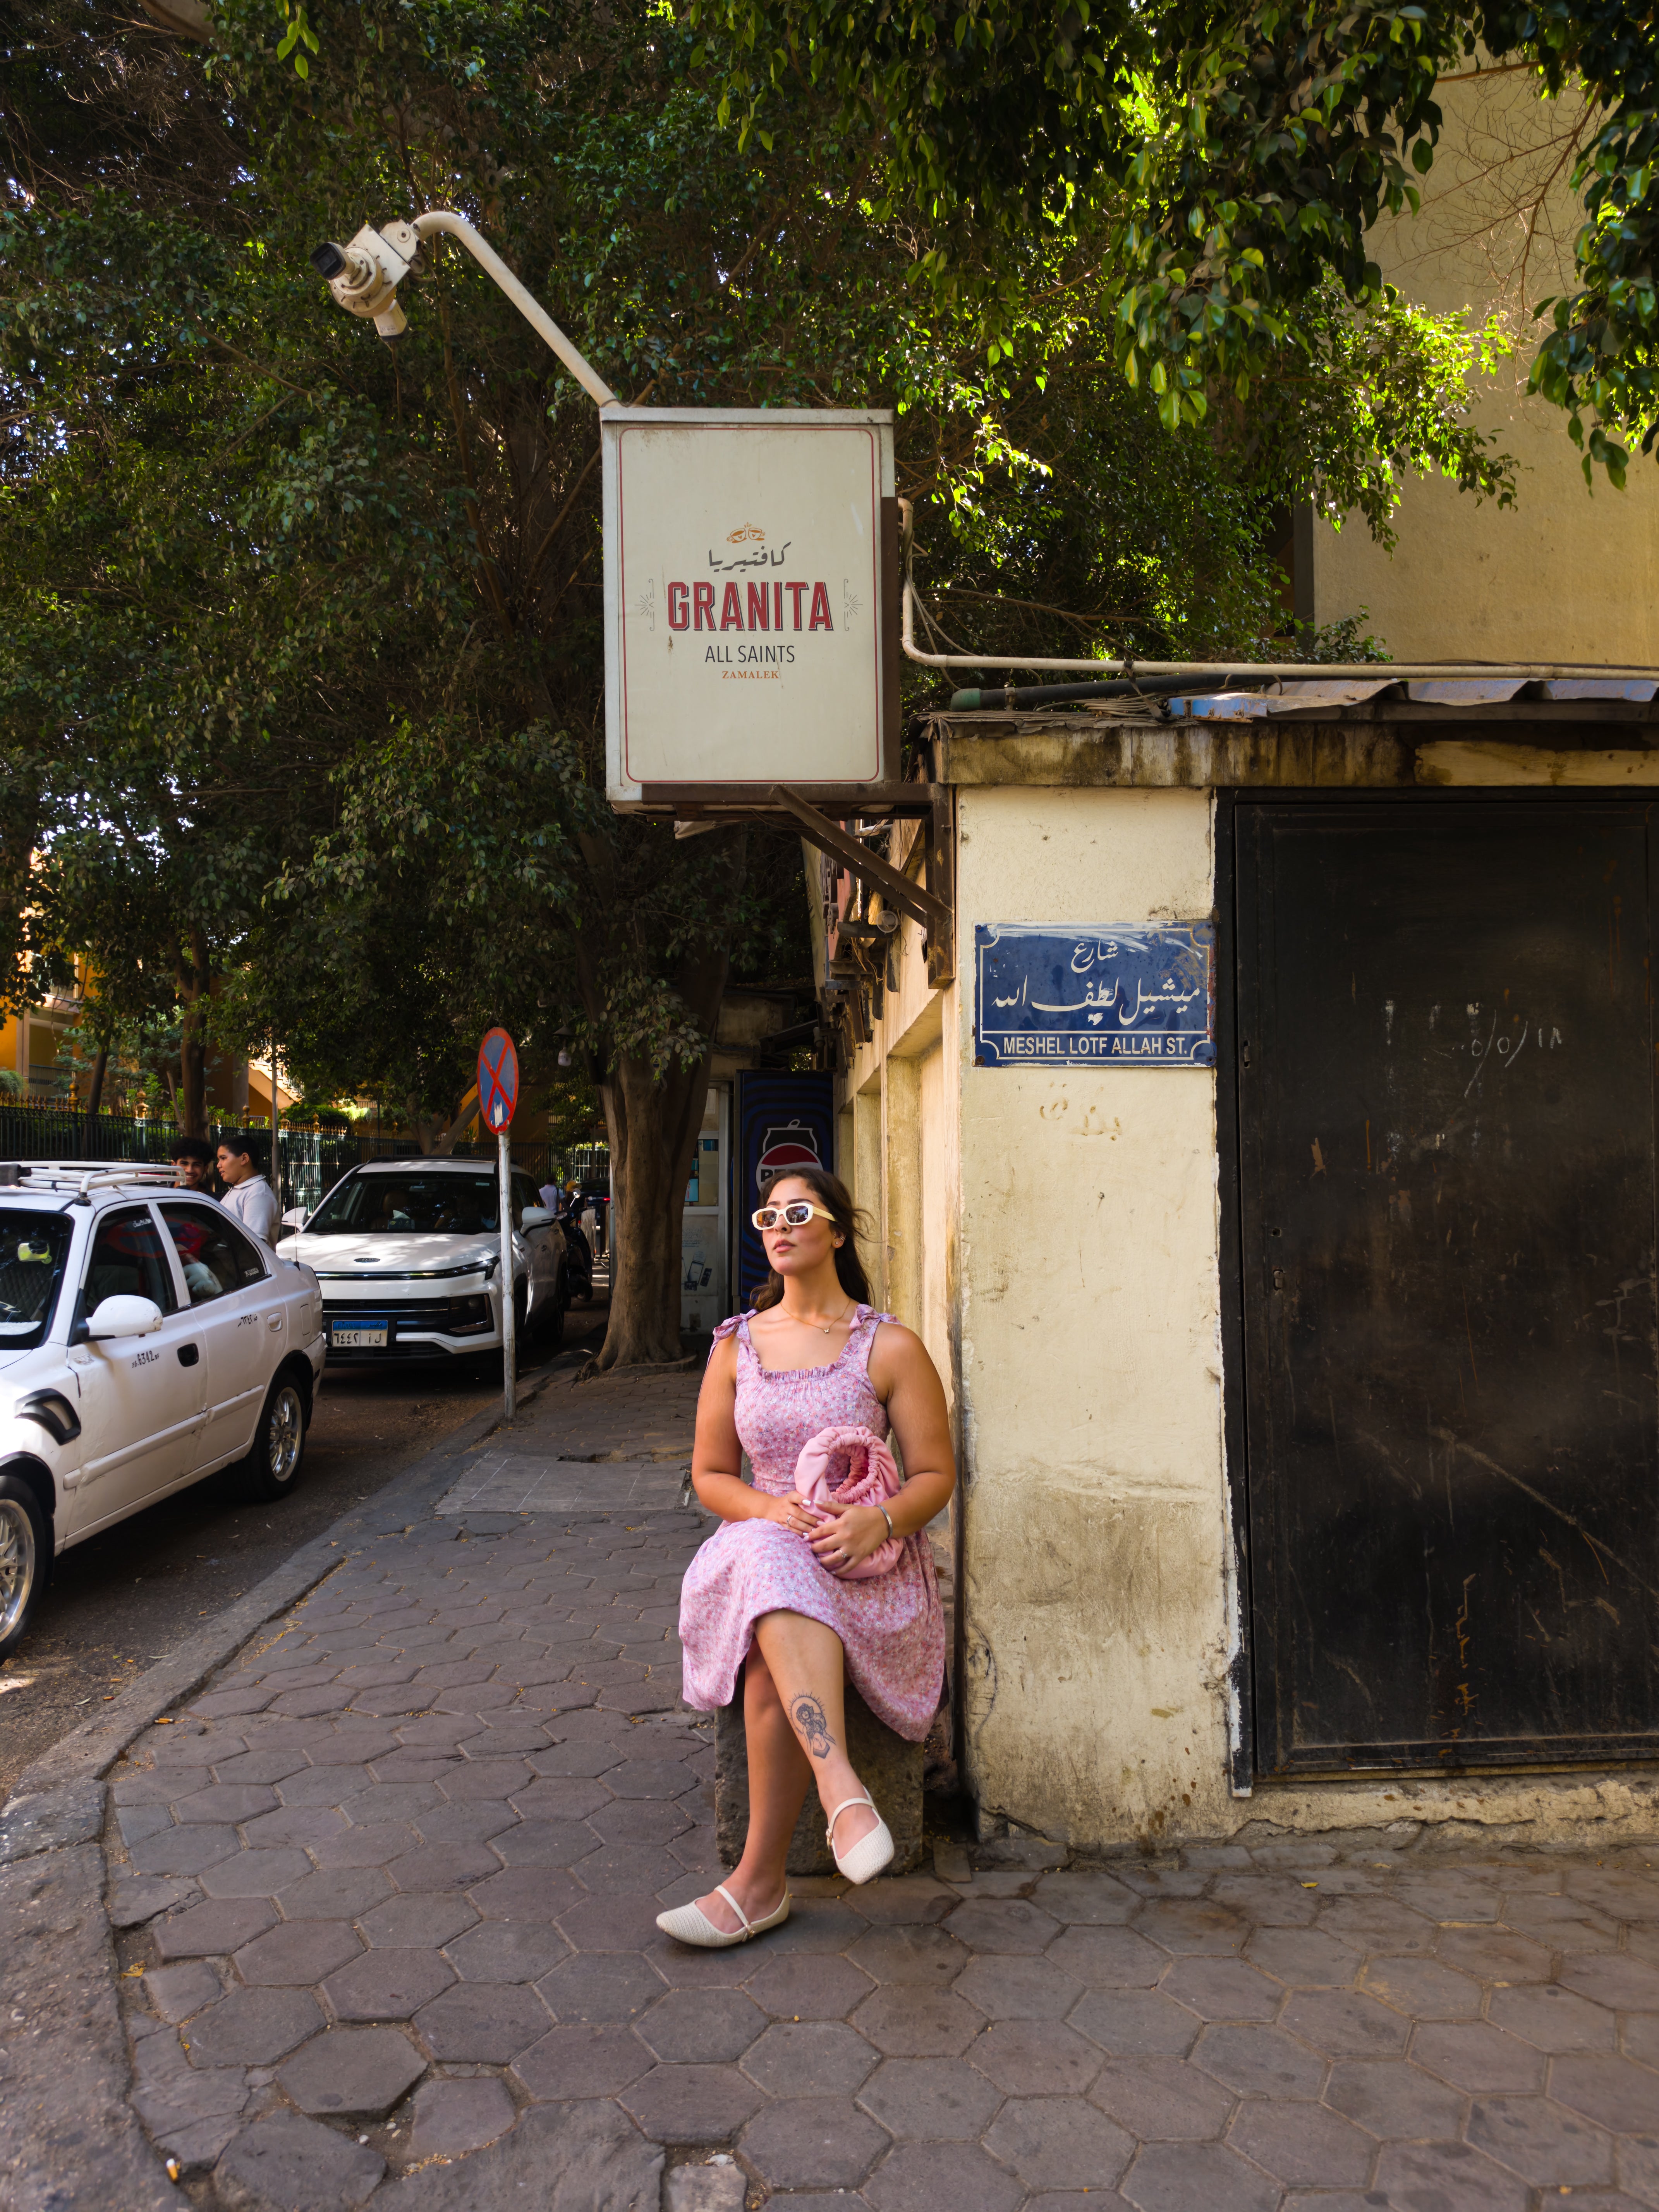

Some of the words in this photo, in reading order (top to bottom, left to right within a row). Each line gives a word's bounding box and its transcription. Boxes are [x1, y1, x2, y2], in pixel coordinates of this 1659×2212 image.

[709, 541, 791, 572] كافتيريا
[668, 582, 834, 631] GRANITA
[705, 646, 733, 663] ALL
[738, 645, 795, 663] SAINTS
[722, 671, 779, 679] ZAMALEK
[1071, 939, 1118, 973] شارع
[991, 974, 1028, 1008] الله
[1031, 977, 1119, 1012] لطف
[1119, 977, 1200, 1026] ميشيل
[1003, 1037, 1065, 1054] MESHEL
[1069, 1037, 1107, 1054] LOTF
[1111, 1037, 1162, 1054] ALLAH
[1166, 1037, 1187, 1054] ST.
[334, 1333, 359, 1344] ٦٤٤٢
